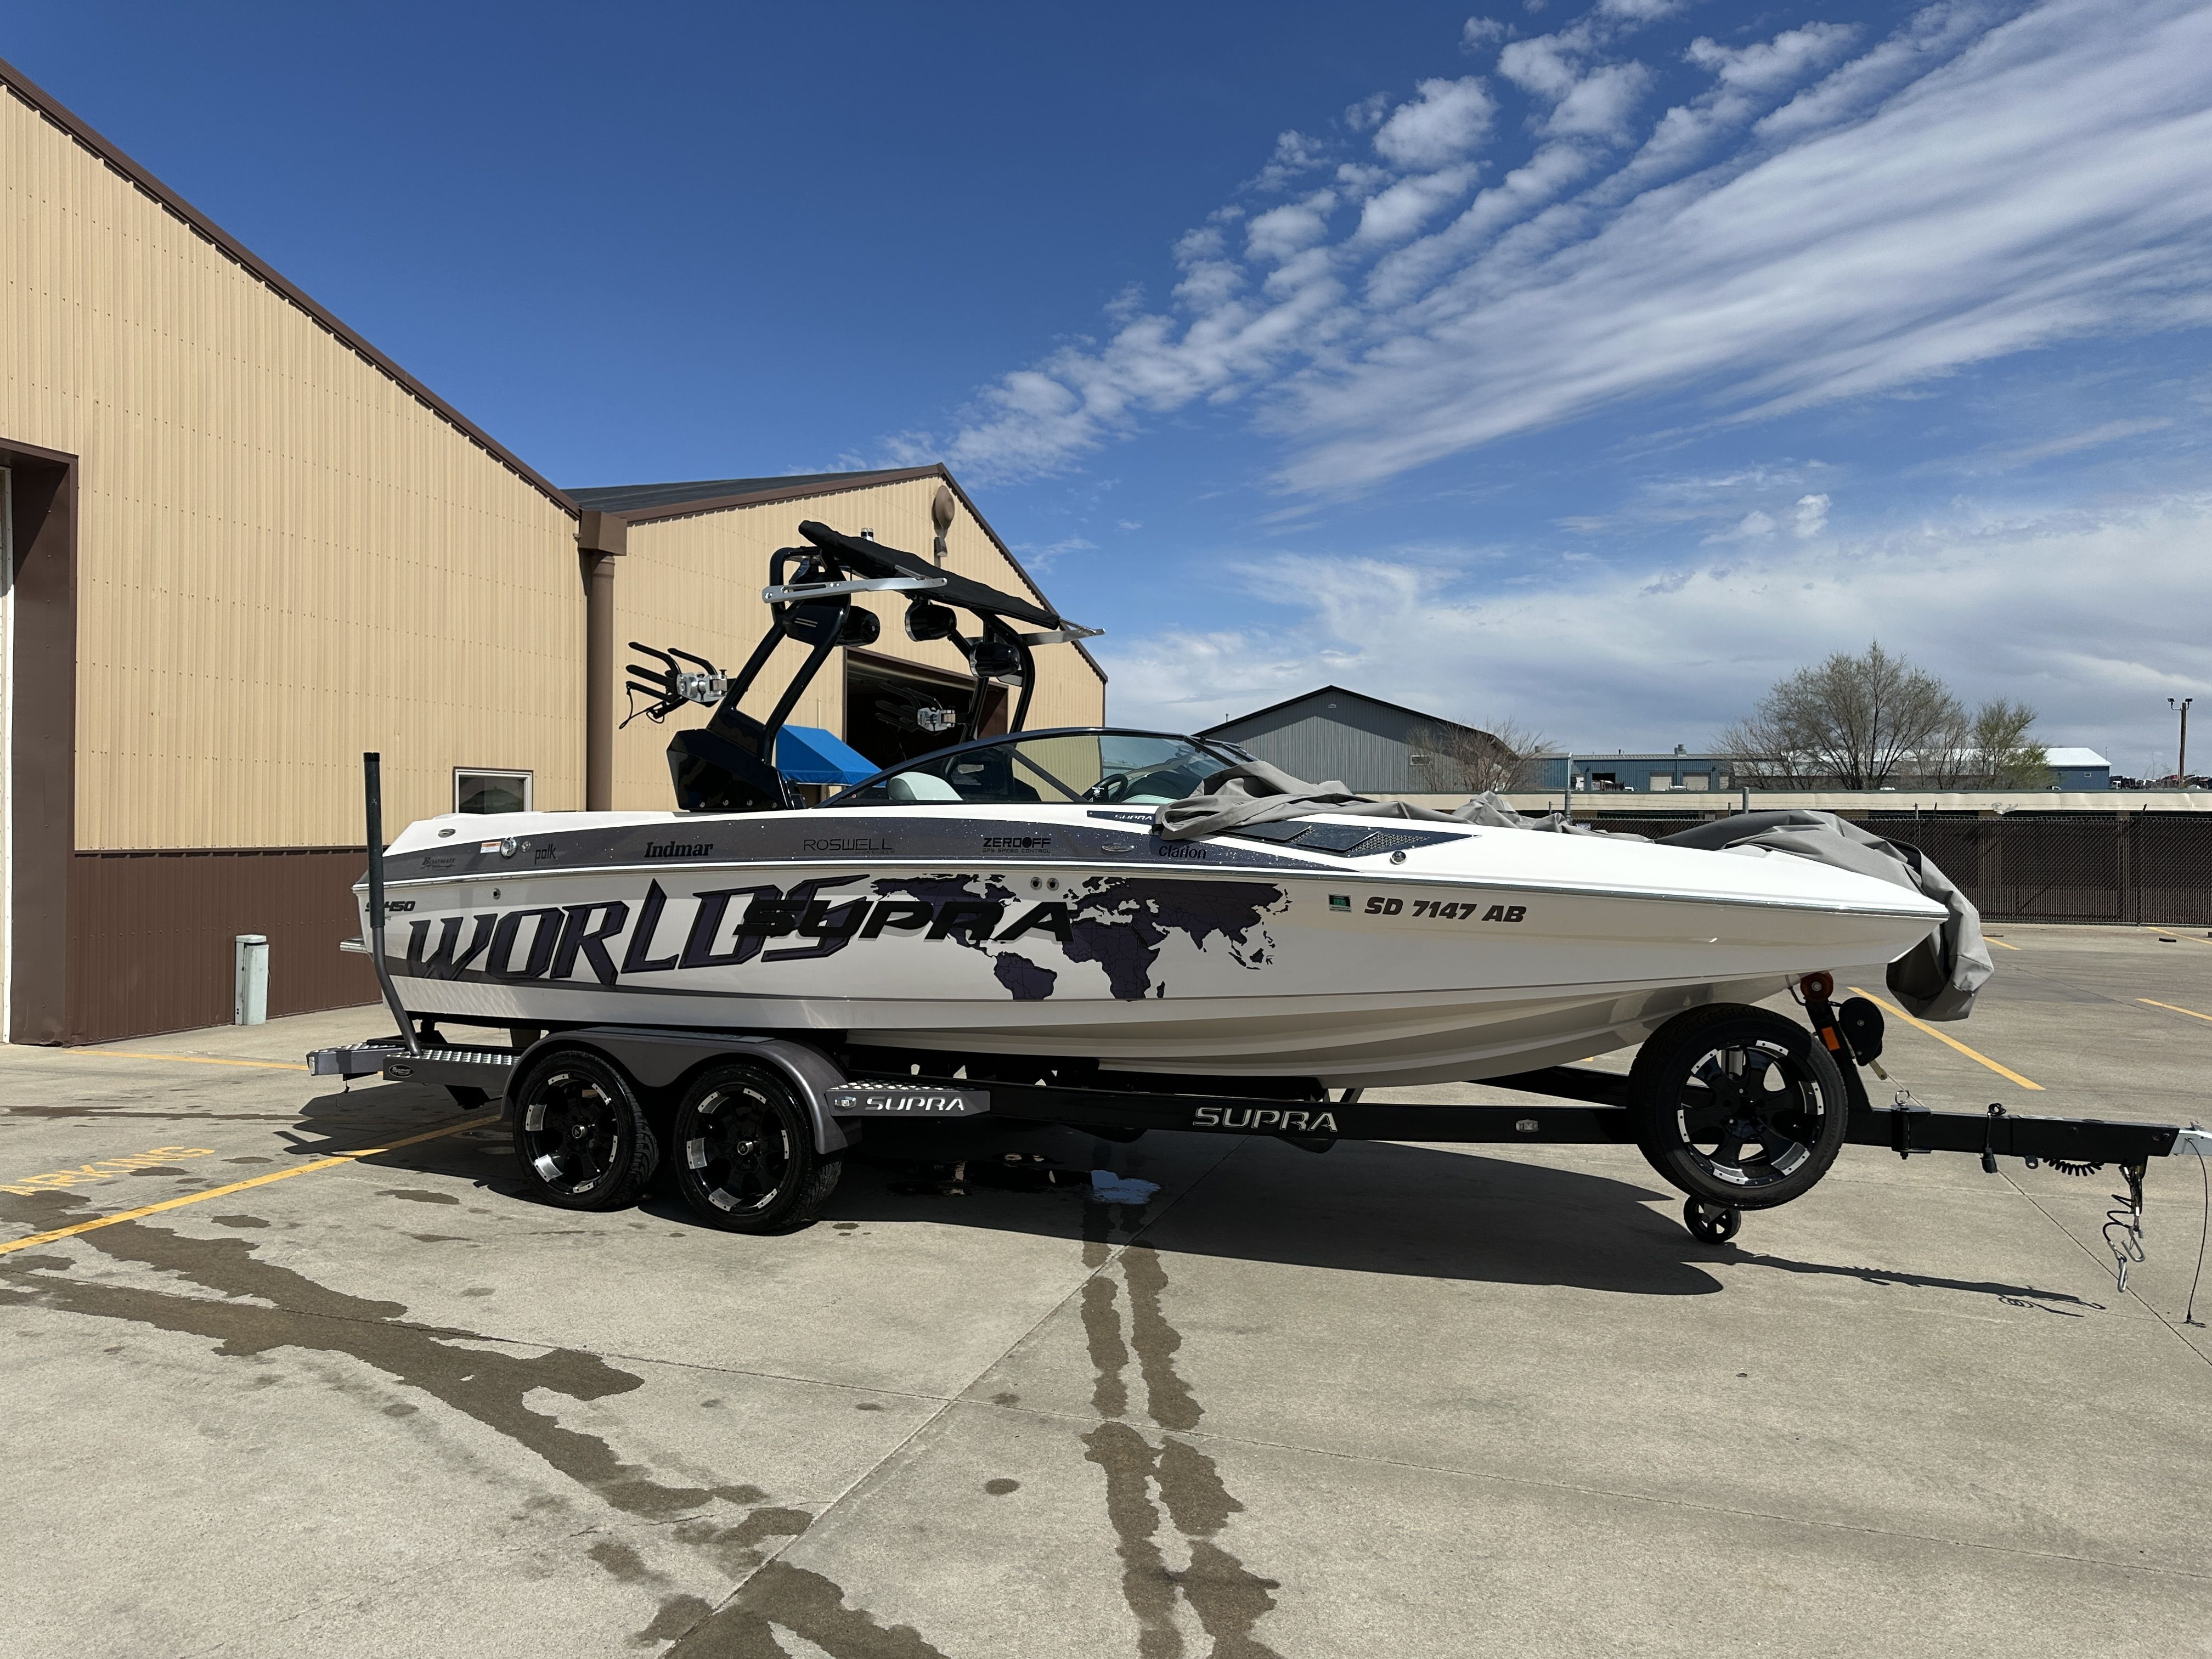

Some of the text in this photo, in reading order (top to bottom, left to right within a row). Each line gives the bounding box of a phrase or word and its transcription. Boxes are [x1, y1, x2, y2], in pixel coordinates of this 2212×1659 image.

[534, 843, 556, 865] polk
[644, 841, 714, 858] Indmar
[804, 838, 893, 850] ROSWELL
[1364, 896, 1403, 915] SD
[1412, 900, 1477, 919] 7147
[1481, 905, 1527, 922] AB
[732, 900, 1074, 942] SUPRA
[865, 1096, 965, 1111] SUPRA
[1193, 1107, 1338, 1132] SUPRA
